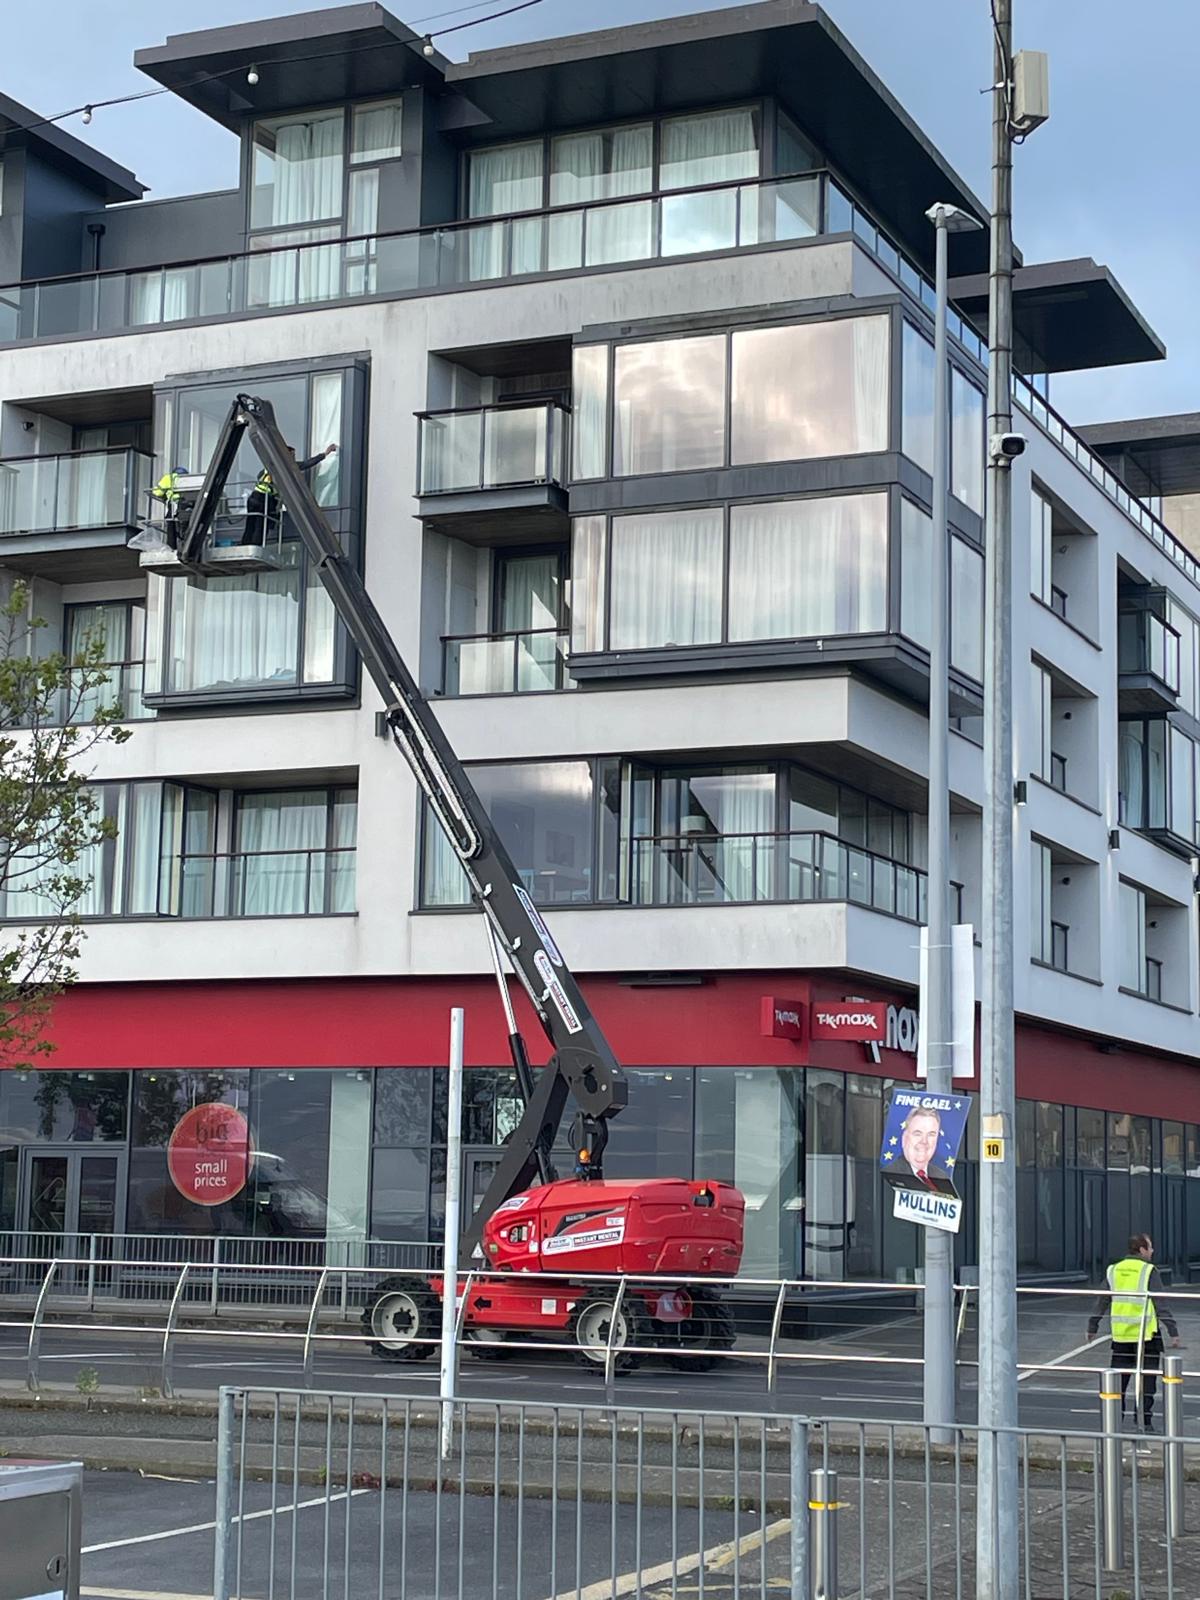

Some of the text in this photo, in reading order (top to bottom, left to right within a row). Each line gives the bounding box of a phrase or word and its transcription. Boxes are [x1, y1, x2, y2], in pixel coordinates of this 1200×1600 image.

[895, 1095, 952, 1111] FINE GAEL
[987, 1144, 999, 1156] 10
[195, 1160, 228, 1174] small
[194, 1175, 227, 1191] prices
[899, 1191, 957, 1219] MULLINS
